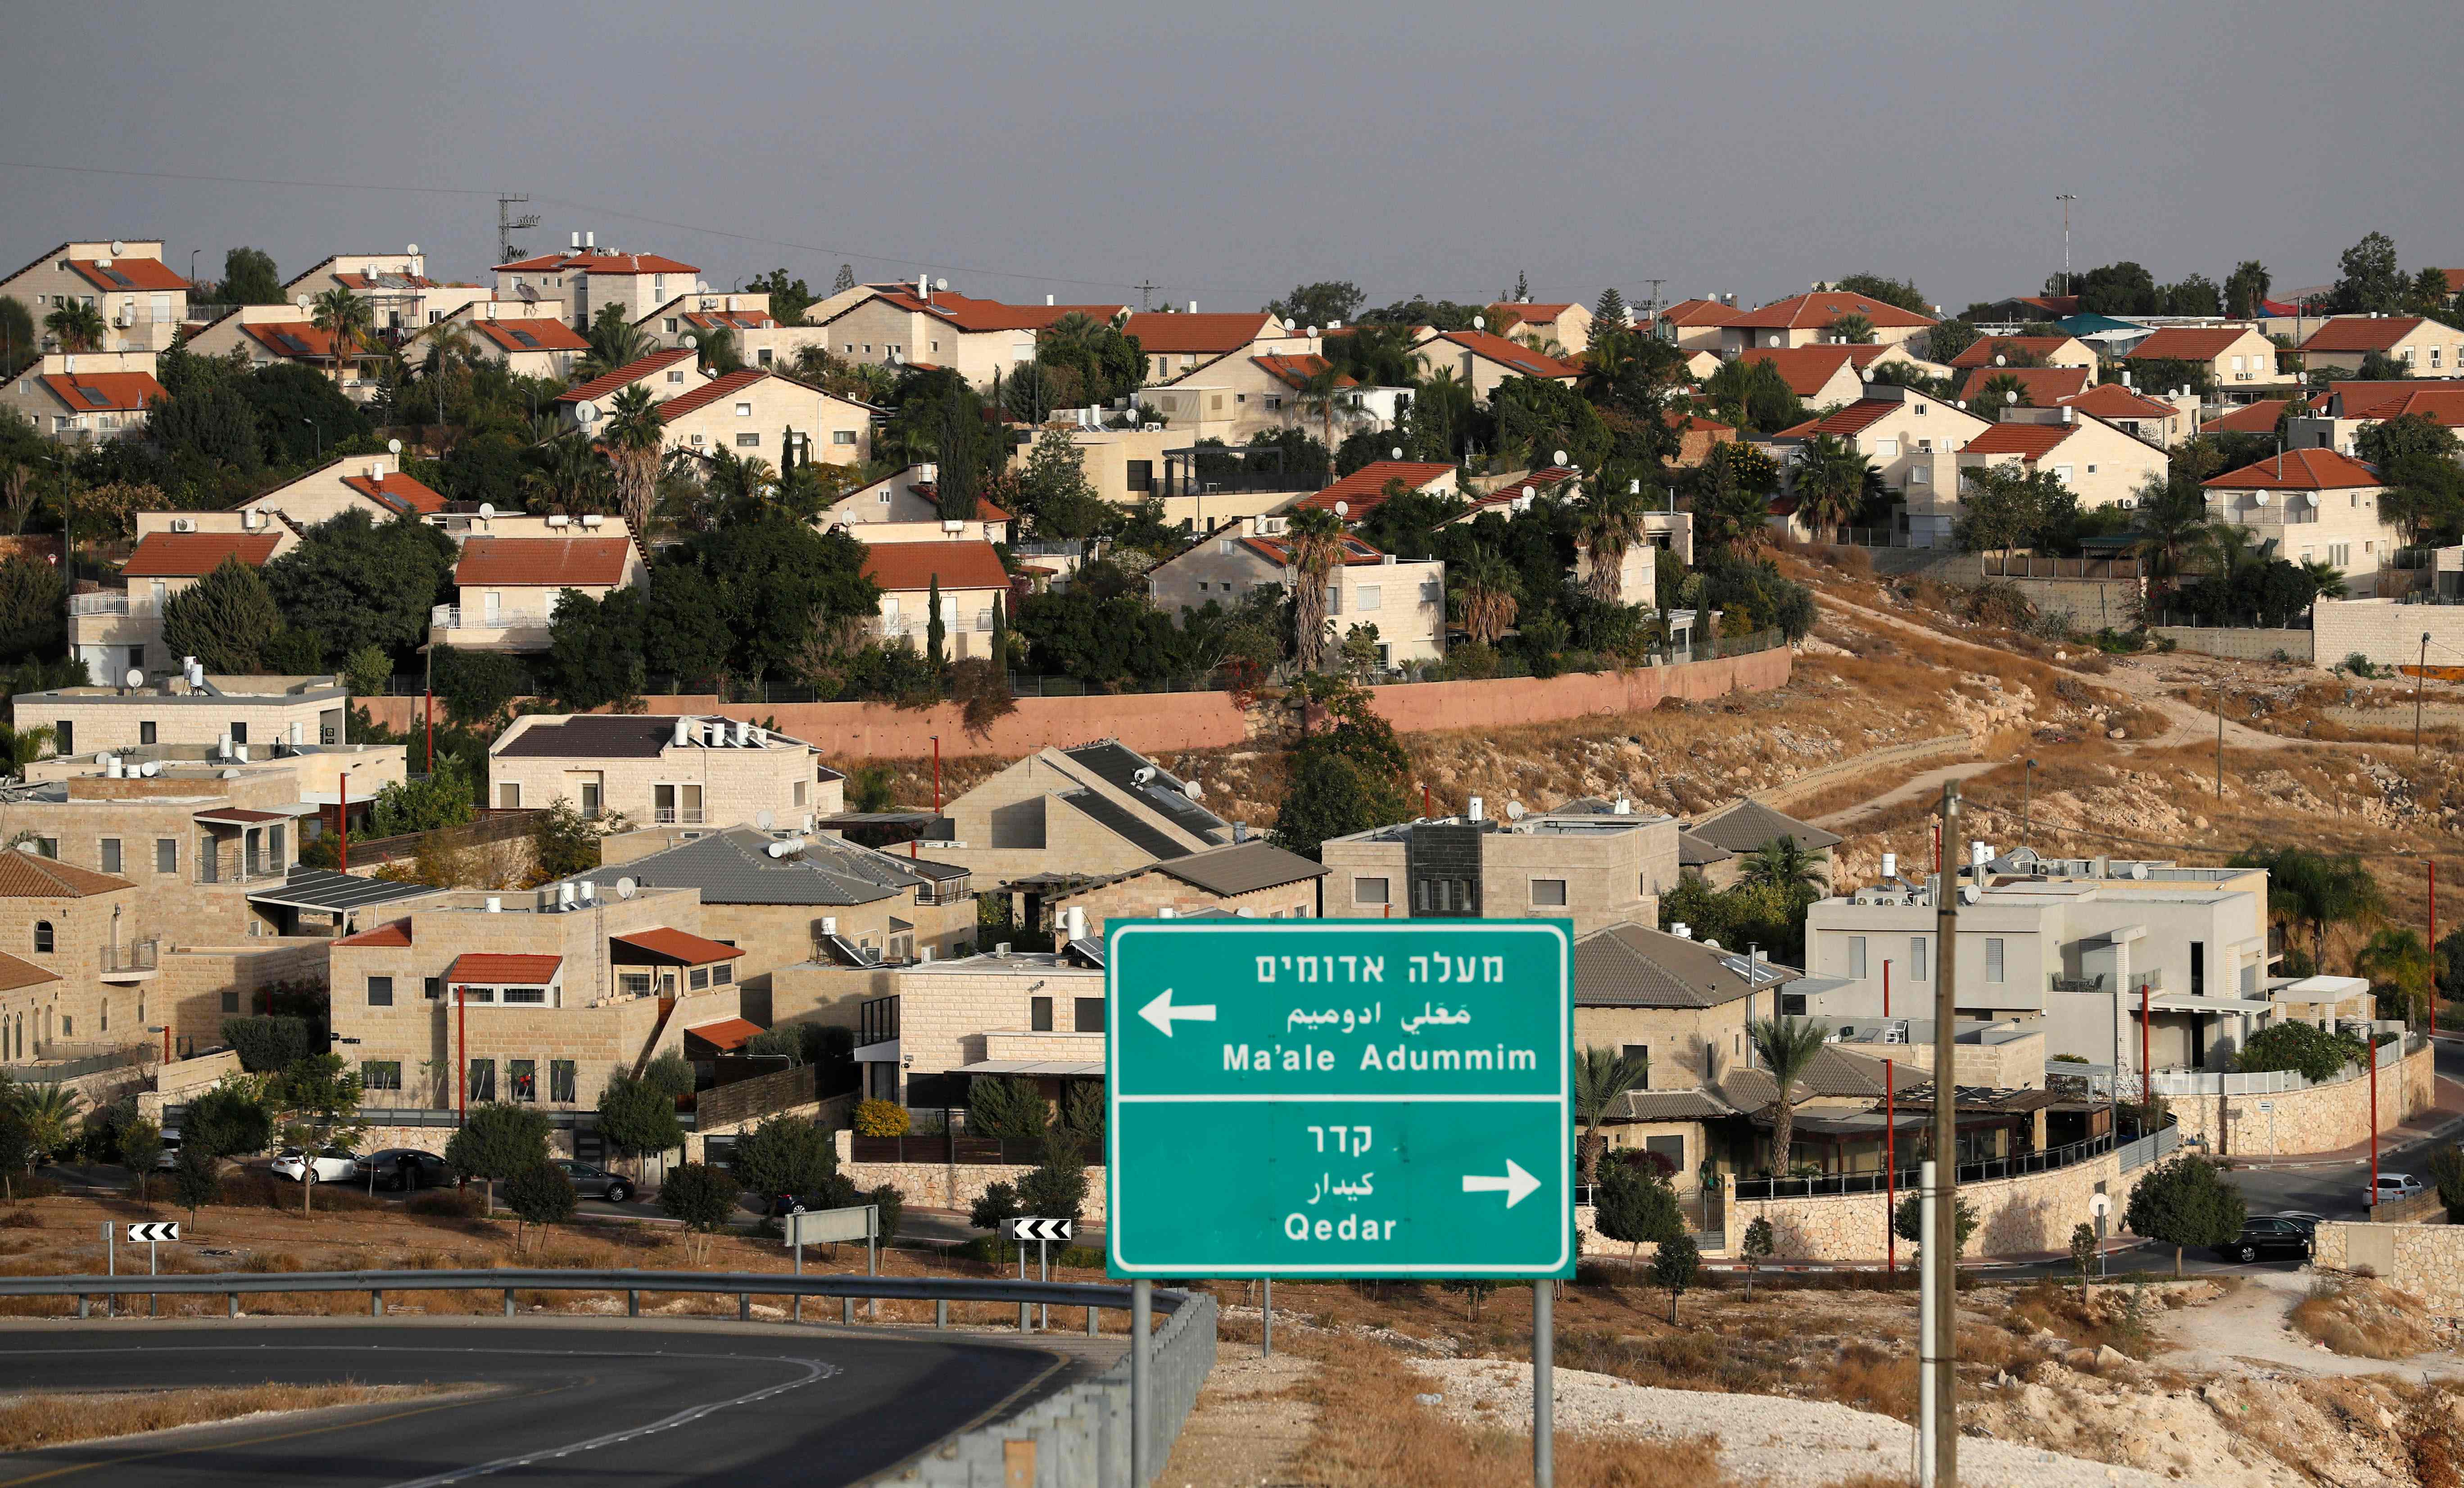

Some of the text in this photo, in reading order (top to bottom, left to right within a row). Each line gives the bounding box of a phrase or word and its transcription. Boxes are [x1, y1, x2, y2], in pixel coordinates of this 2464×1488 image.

[1256, 952, 1503, 982] מעלה אדומים
[1288, 1002, 1380, 1033] ادوميم
[1224, 1044, 1535, 1071] Ma’ale Adummim
[1308, 1126, 1372, 1157] קדר
[1307, 1173, 1374, 1204] كيدار
[1285, 1213, 1396, 1240] Qedar
